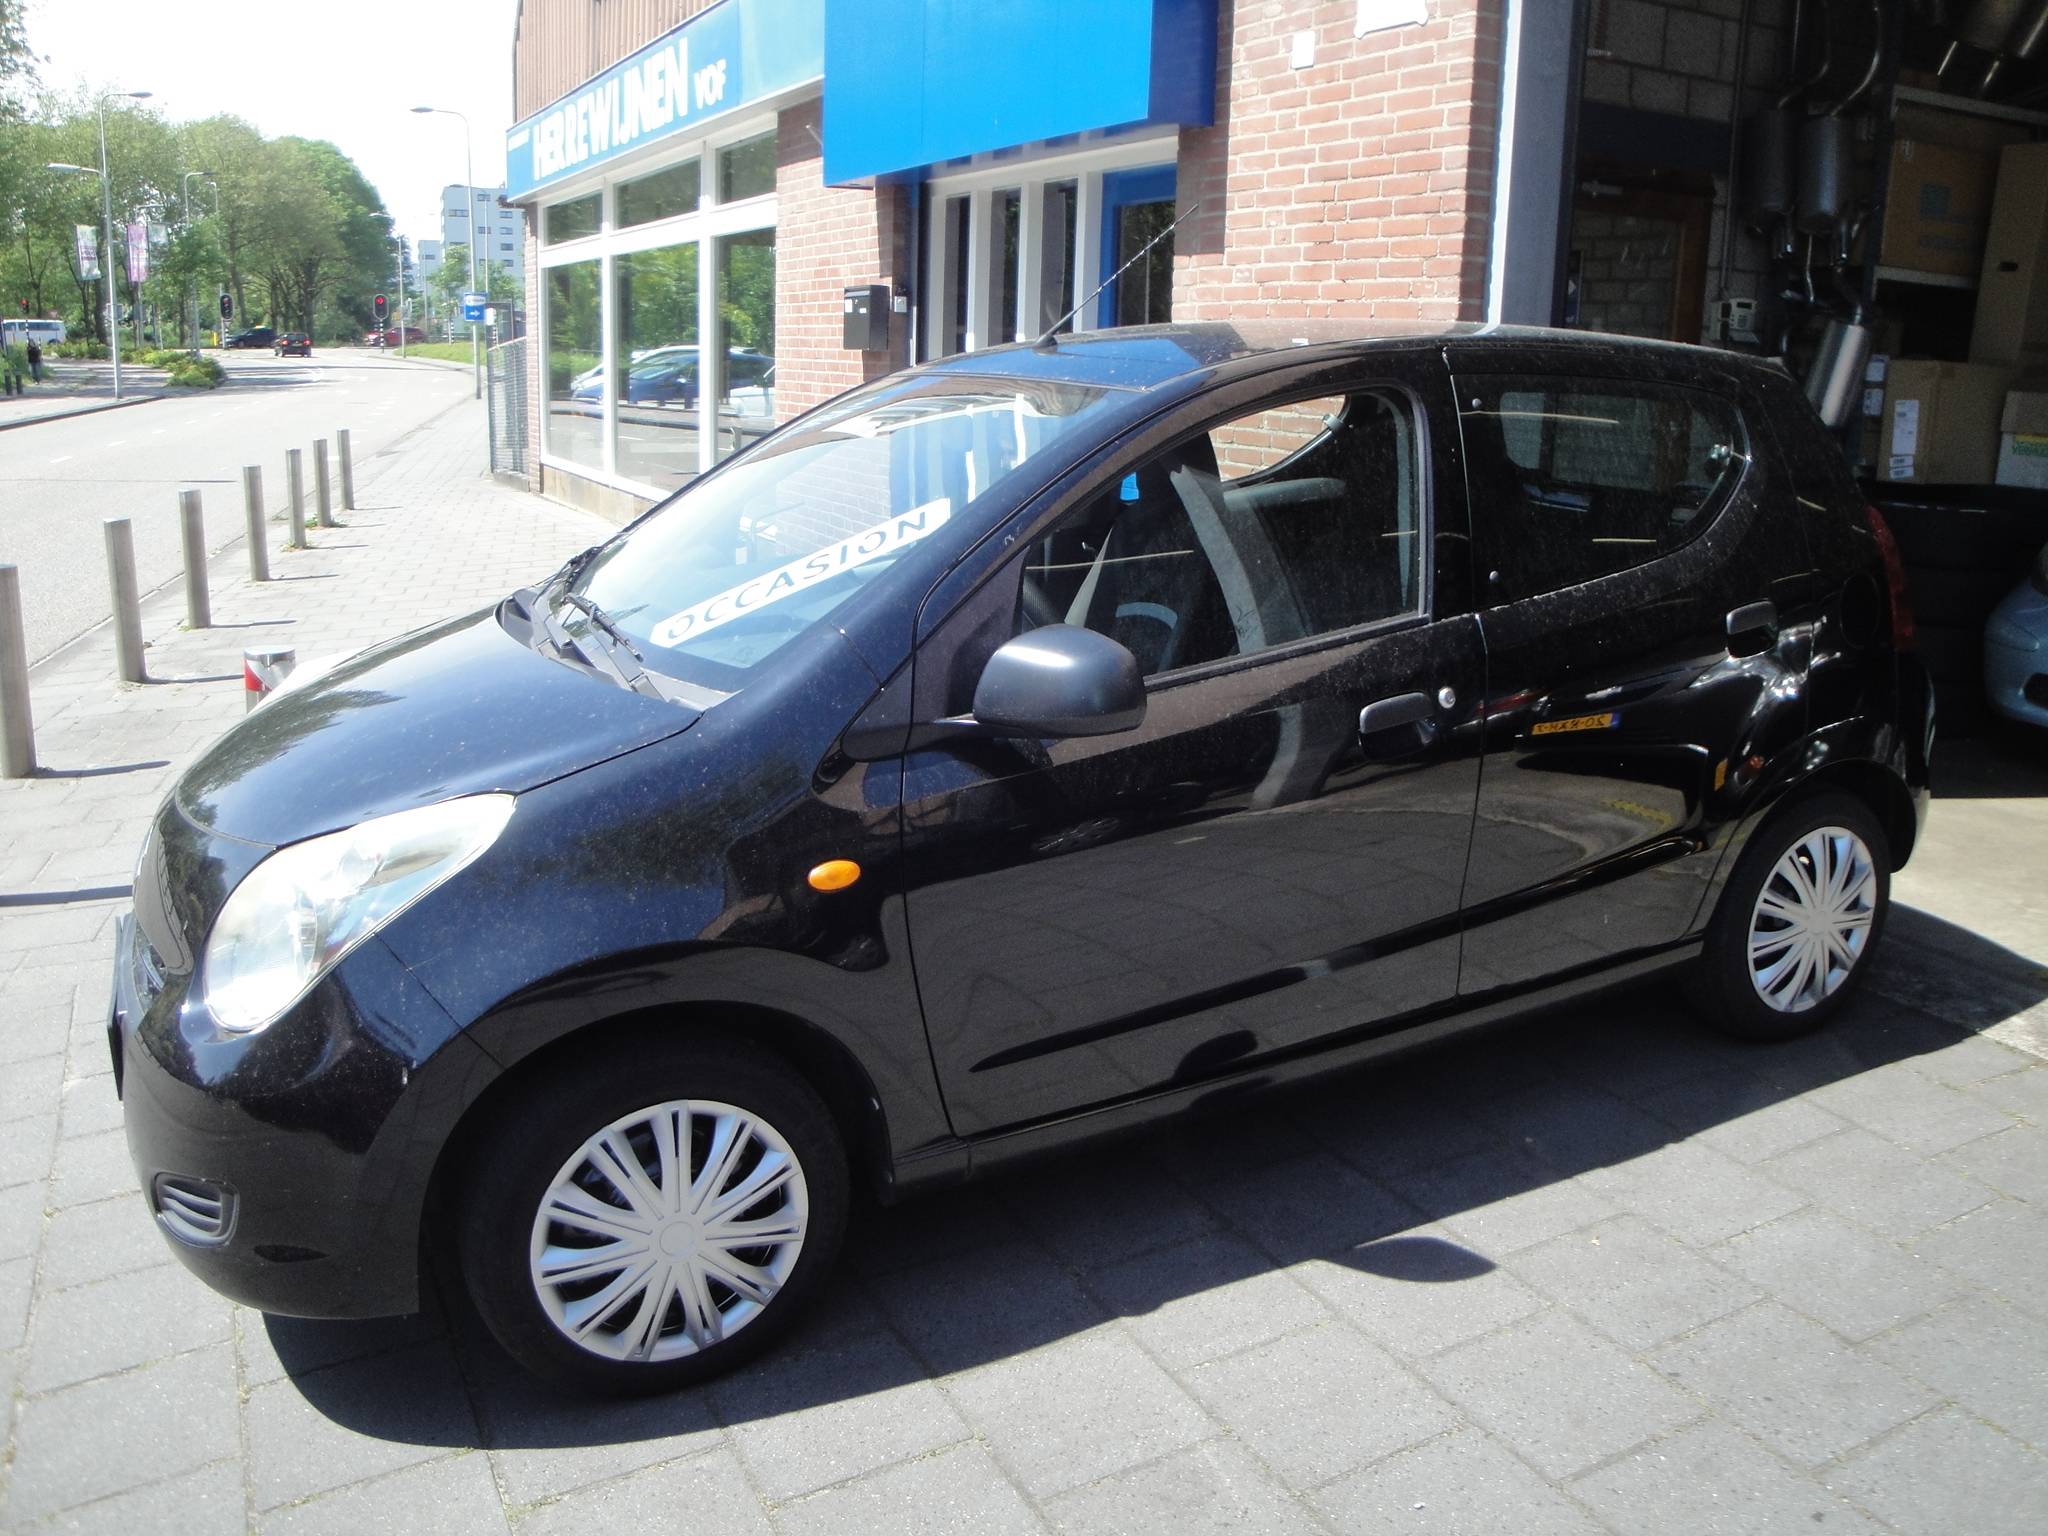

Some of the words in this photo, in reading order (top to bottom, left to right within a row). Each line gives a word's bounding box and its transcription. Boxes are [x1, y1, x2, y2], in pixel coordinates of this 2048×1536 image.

[532, 38, 688, 180] HERREWIJNEN
[694, 59, 727, 109] VOF
[668, 511, 926, 639] OCCASION
